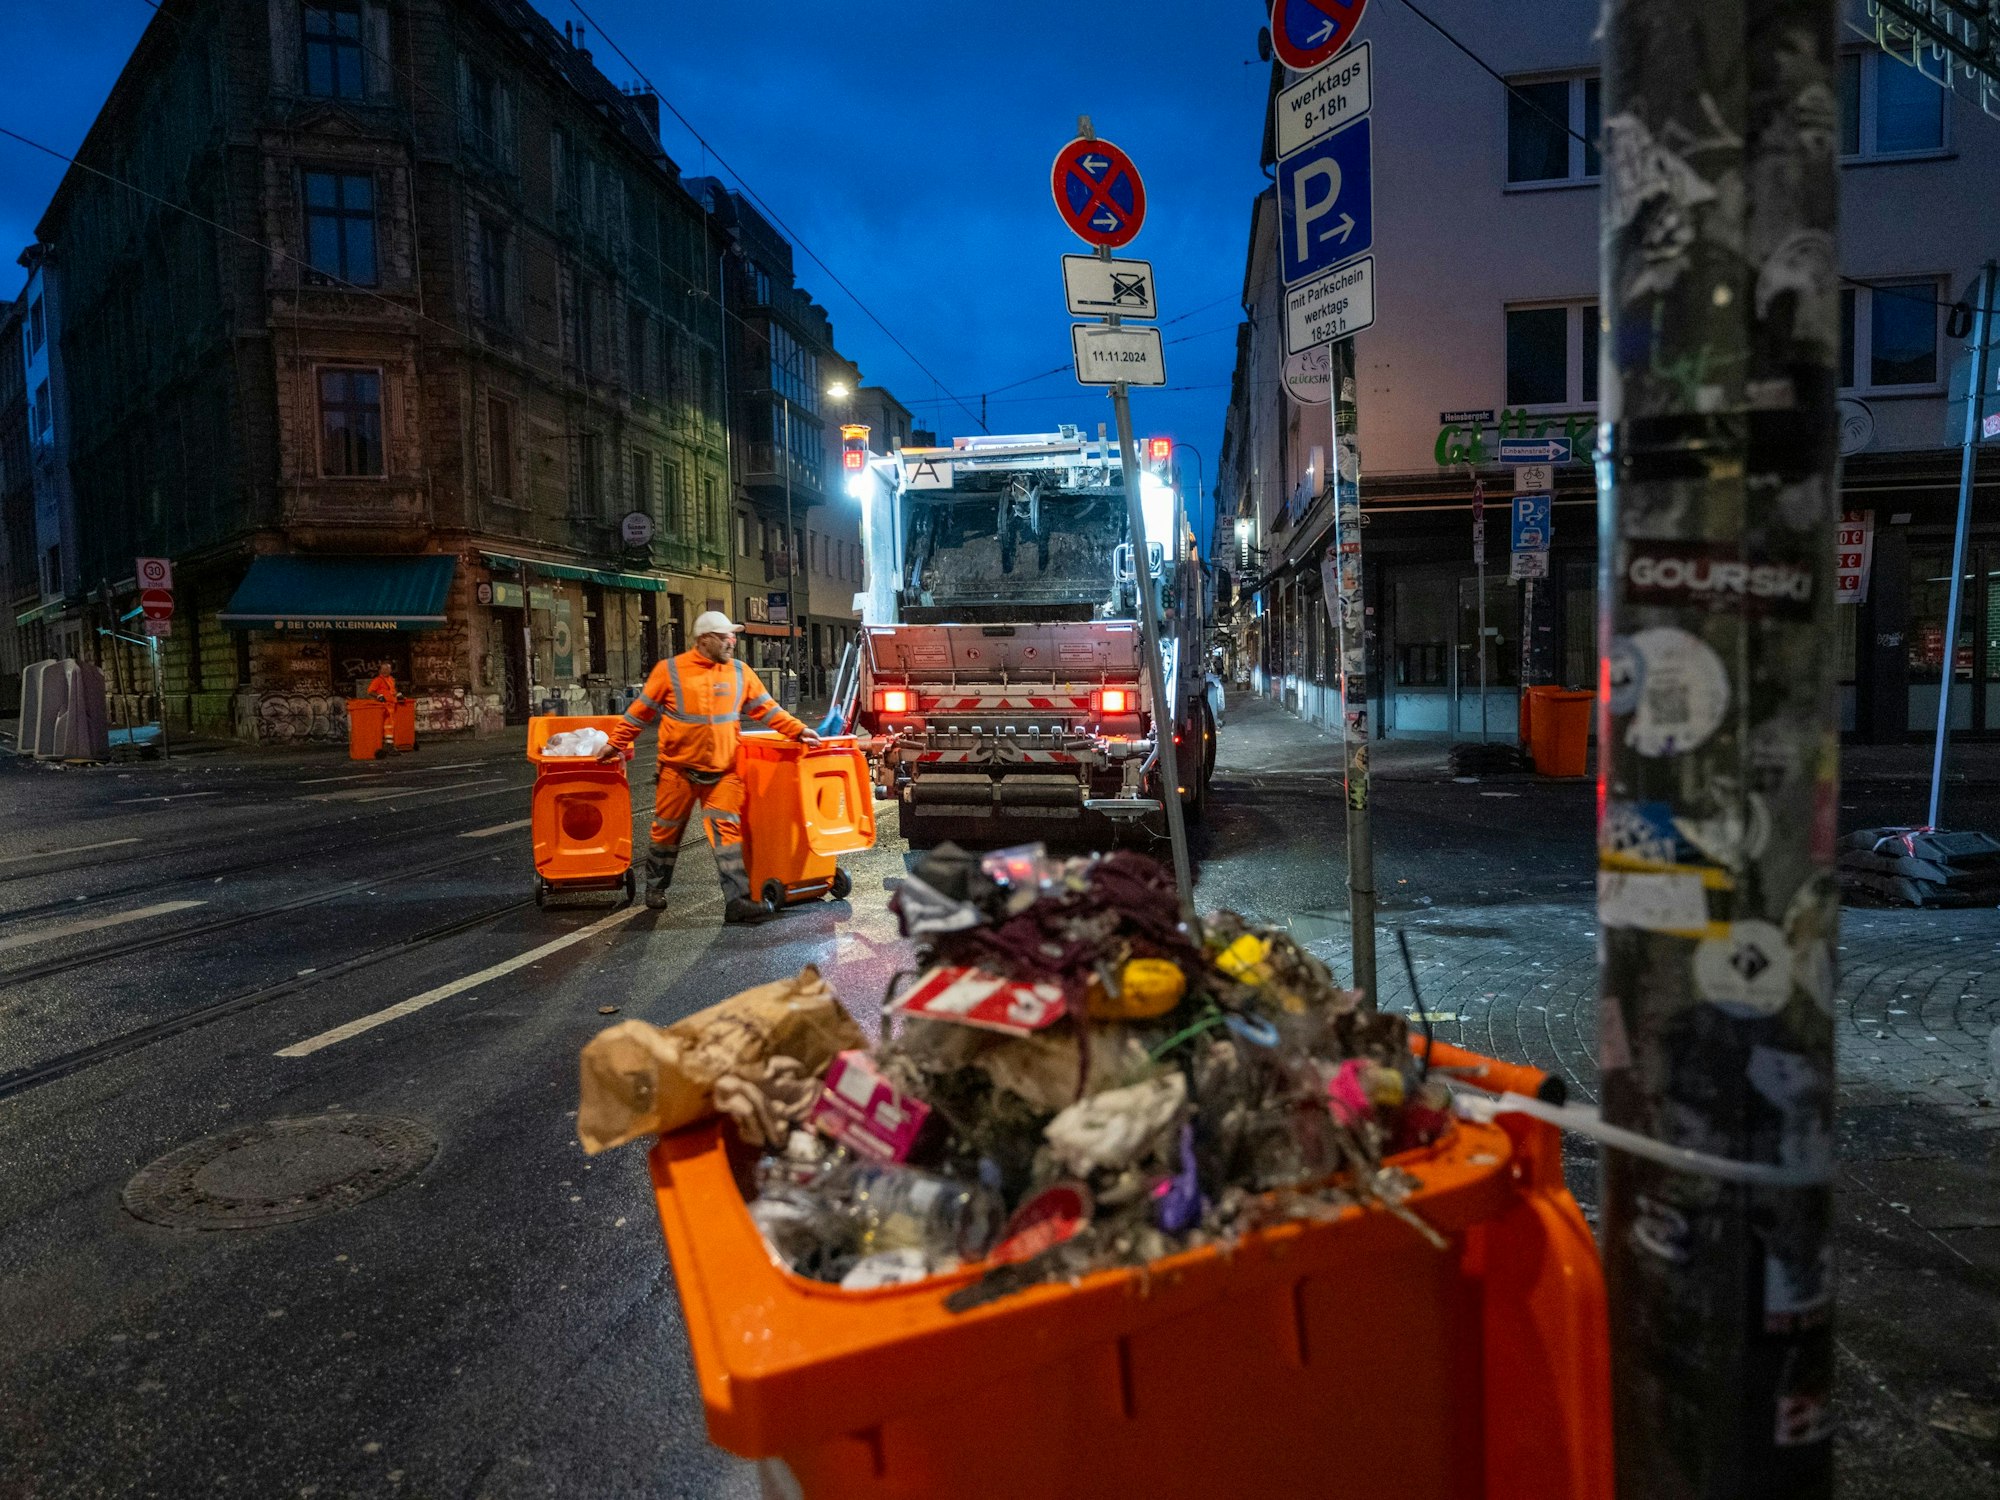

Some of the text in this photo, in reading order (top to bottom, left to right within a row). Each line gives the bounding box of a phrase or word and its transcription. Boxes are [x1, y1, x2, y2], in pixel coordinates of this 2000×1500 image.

[1291, 62, 1361, 112] werktags
[1304, 95, 1347, 129] 8-18h
[1293, 156, 1342, 263] P
[1290, 269, 1364, 312] mit Parkschein
[1304, 297, 1349, 325] werktags
[1311, 317, 1346, 342] 18-23 h
[1092, 350, 1147, 363] 11.11.2024
[1289, 373, 1330, 385] GLÜCKSHU
[1503, 447, 1551, 455] Einbahnstraße
[911, 461, 940, 484] A
[1518, 500, 1535, 523] P
[148, 566, 161, 576] 30
[287, 621, 398, 630] BEI OMA KLEINMANN
